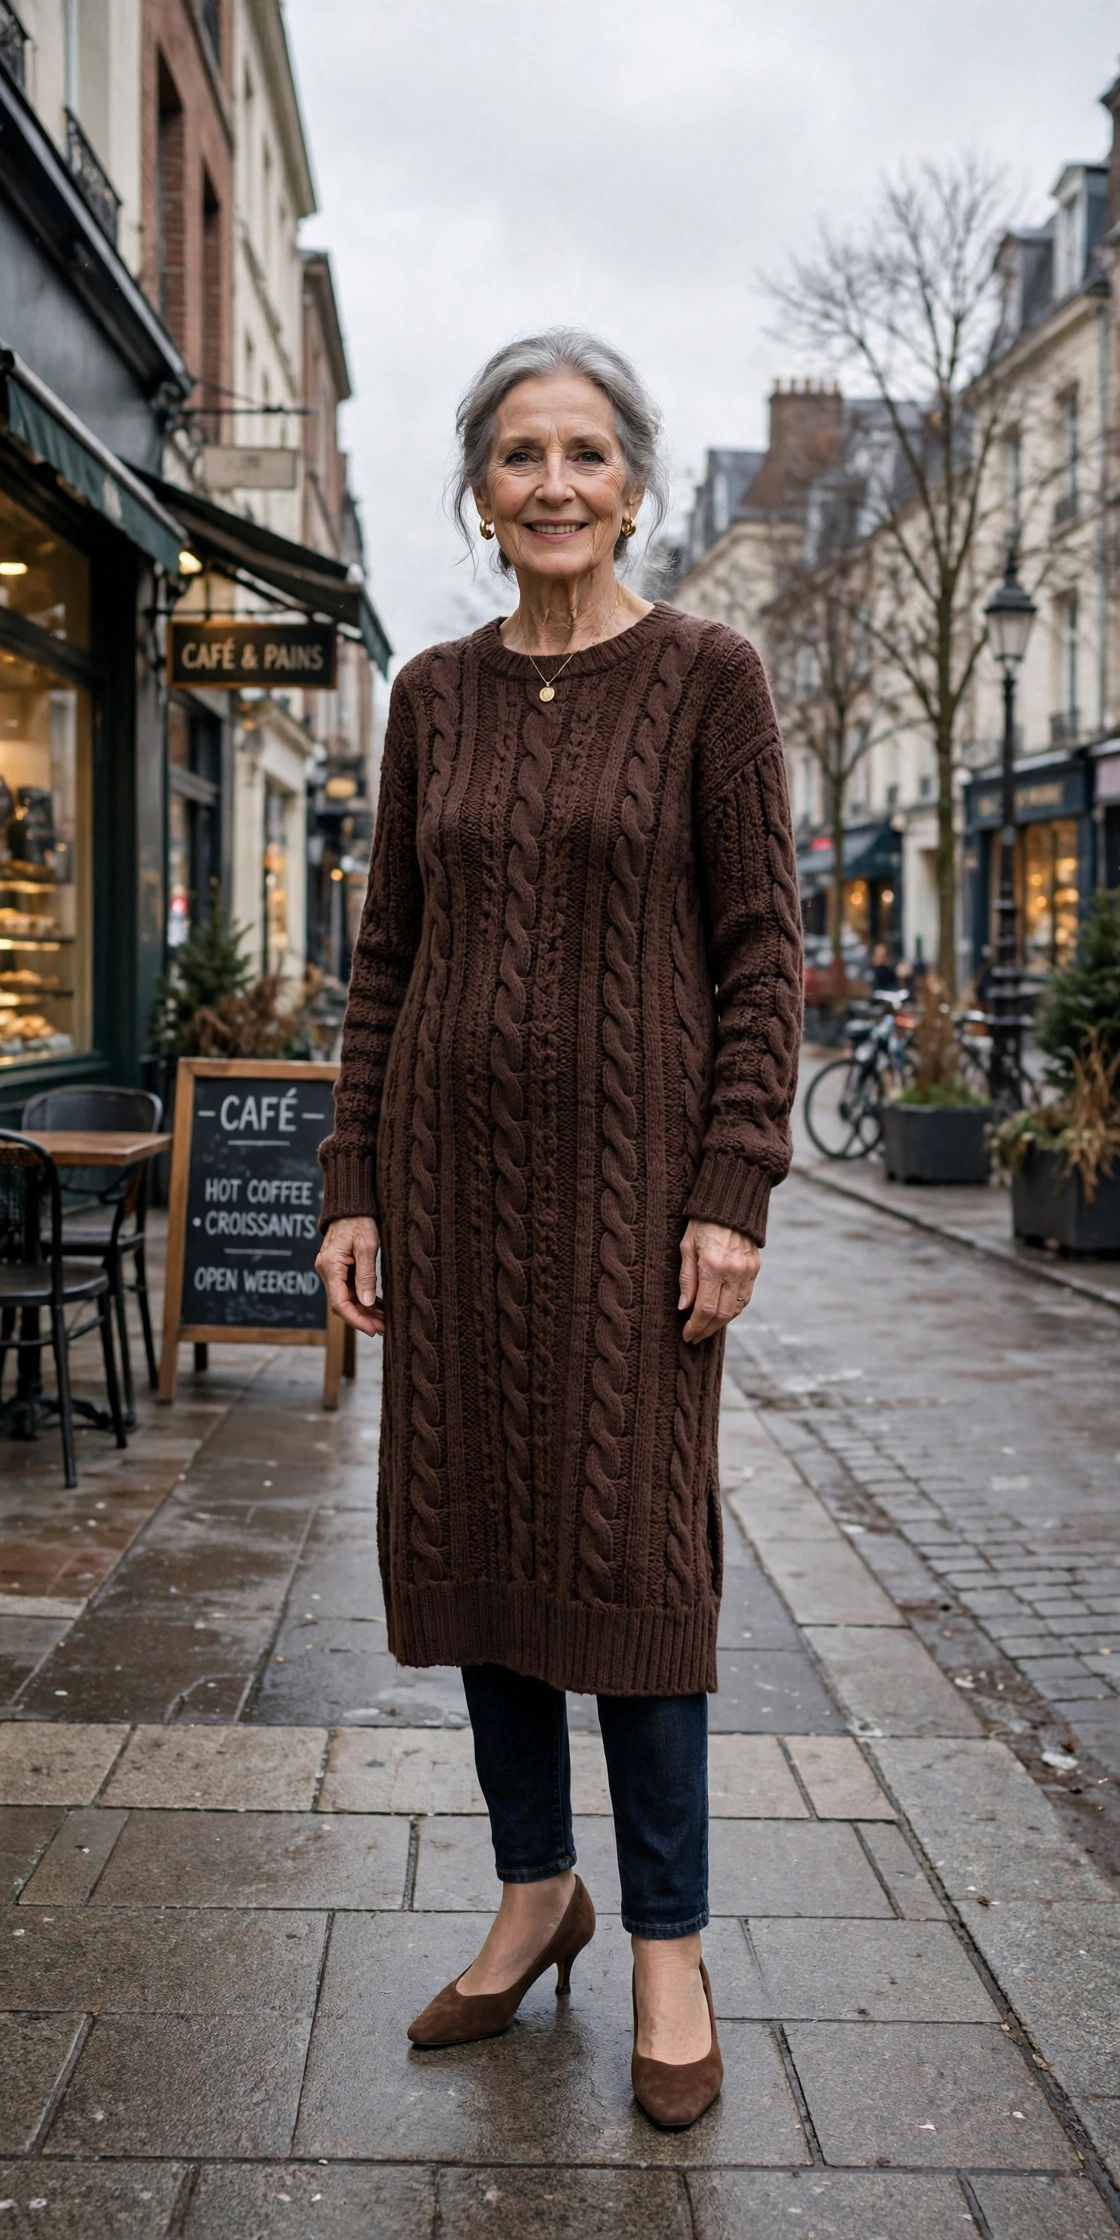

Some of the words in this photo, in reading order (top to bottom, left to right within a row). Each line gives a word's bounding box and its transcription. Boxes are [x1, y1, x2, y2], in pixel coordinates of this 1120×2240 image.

[182, 638, 235, 670] CAFÉ
[242, 643, 258, 670] &
[264, 645, 324, 671] PAINS
[221, 1088, 298, 1132] CAFÉ
[205, 1178, 241, 1203] HOT
[247, 1180, 313, 1206] COFFEE
[205, 1211, 316, 1239] CROISSANTS
[194, 1267, 238, 1292] OPEN
[244, 1270, 319, 1296] WEEKEND
